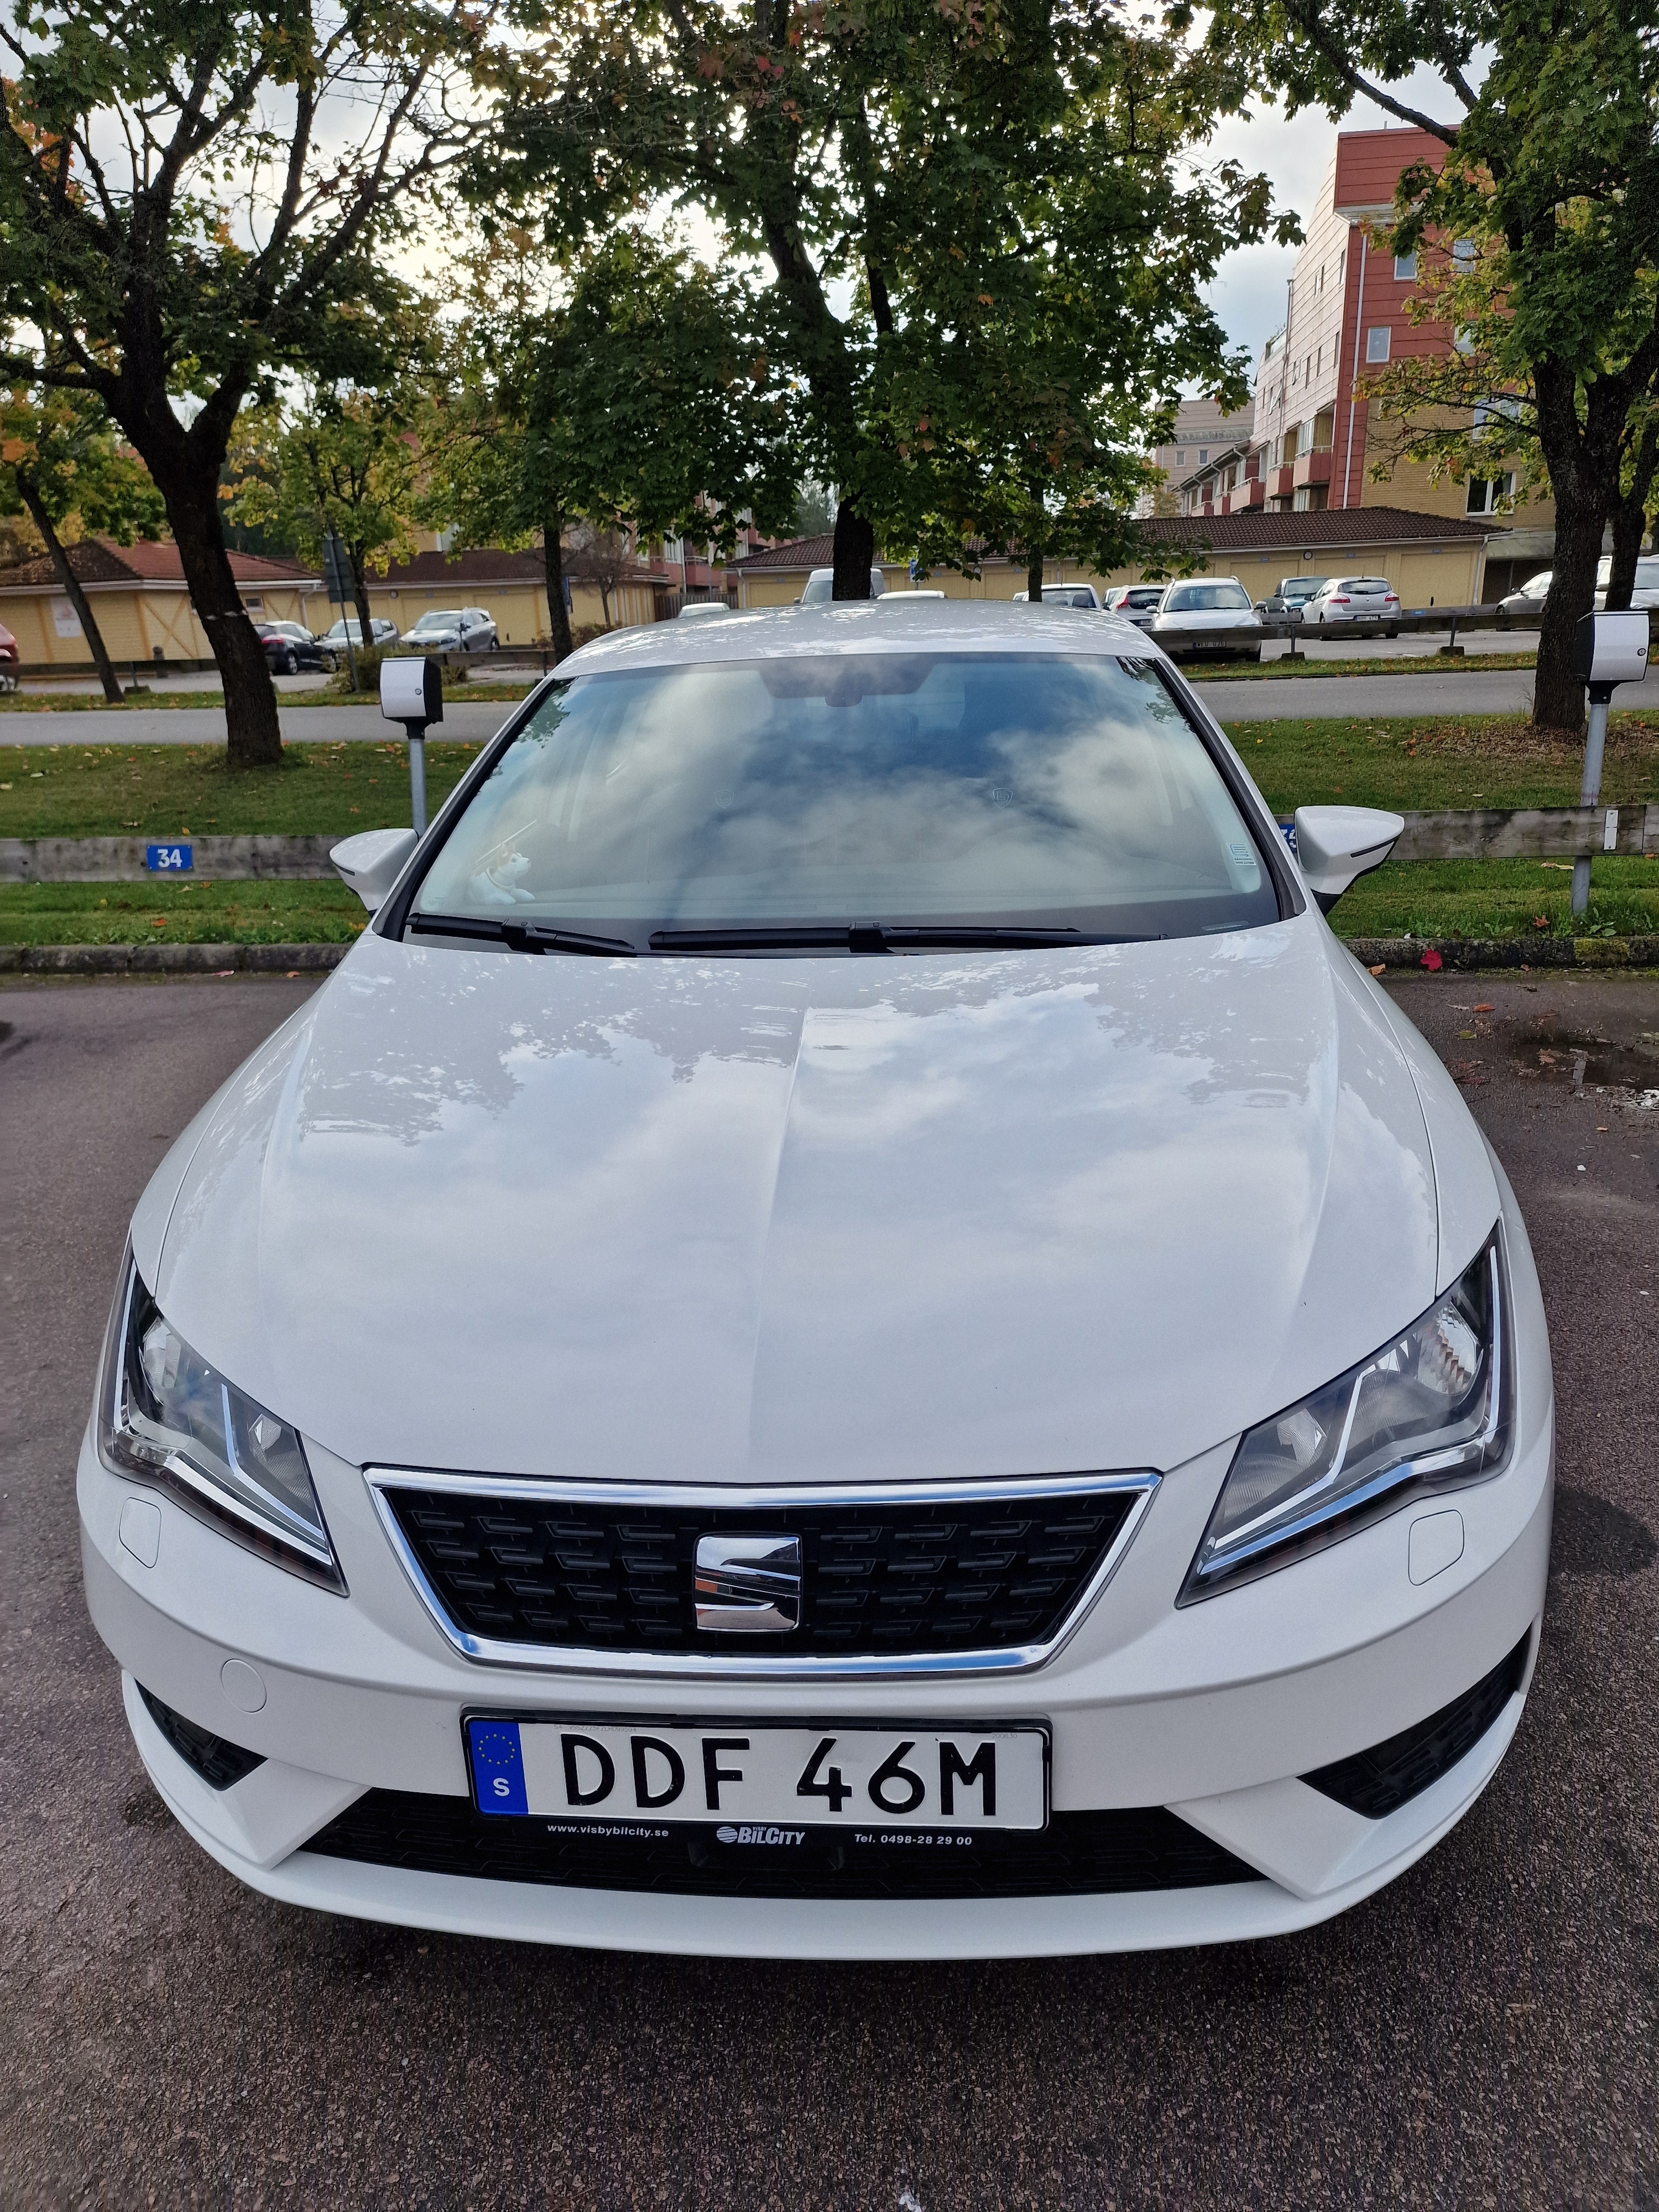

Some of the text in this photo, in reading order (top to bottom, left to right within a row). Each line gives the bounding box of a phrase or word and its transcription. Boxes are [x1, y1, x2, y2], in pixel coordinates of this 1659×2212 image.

[156, 848, 183, 868] 34
[560, 1733, 996, 1816] DDF 46M
[492, 1777, 510, 1797] S
[547, 1825, 669, 1838] www.visbybilcity.se
[854, 1834, 972, 1845] Tel. 0498-28 29 00
